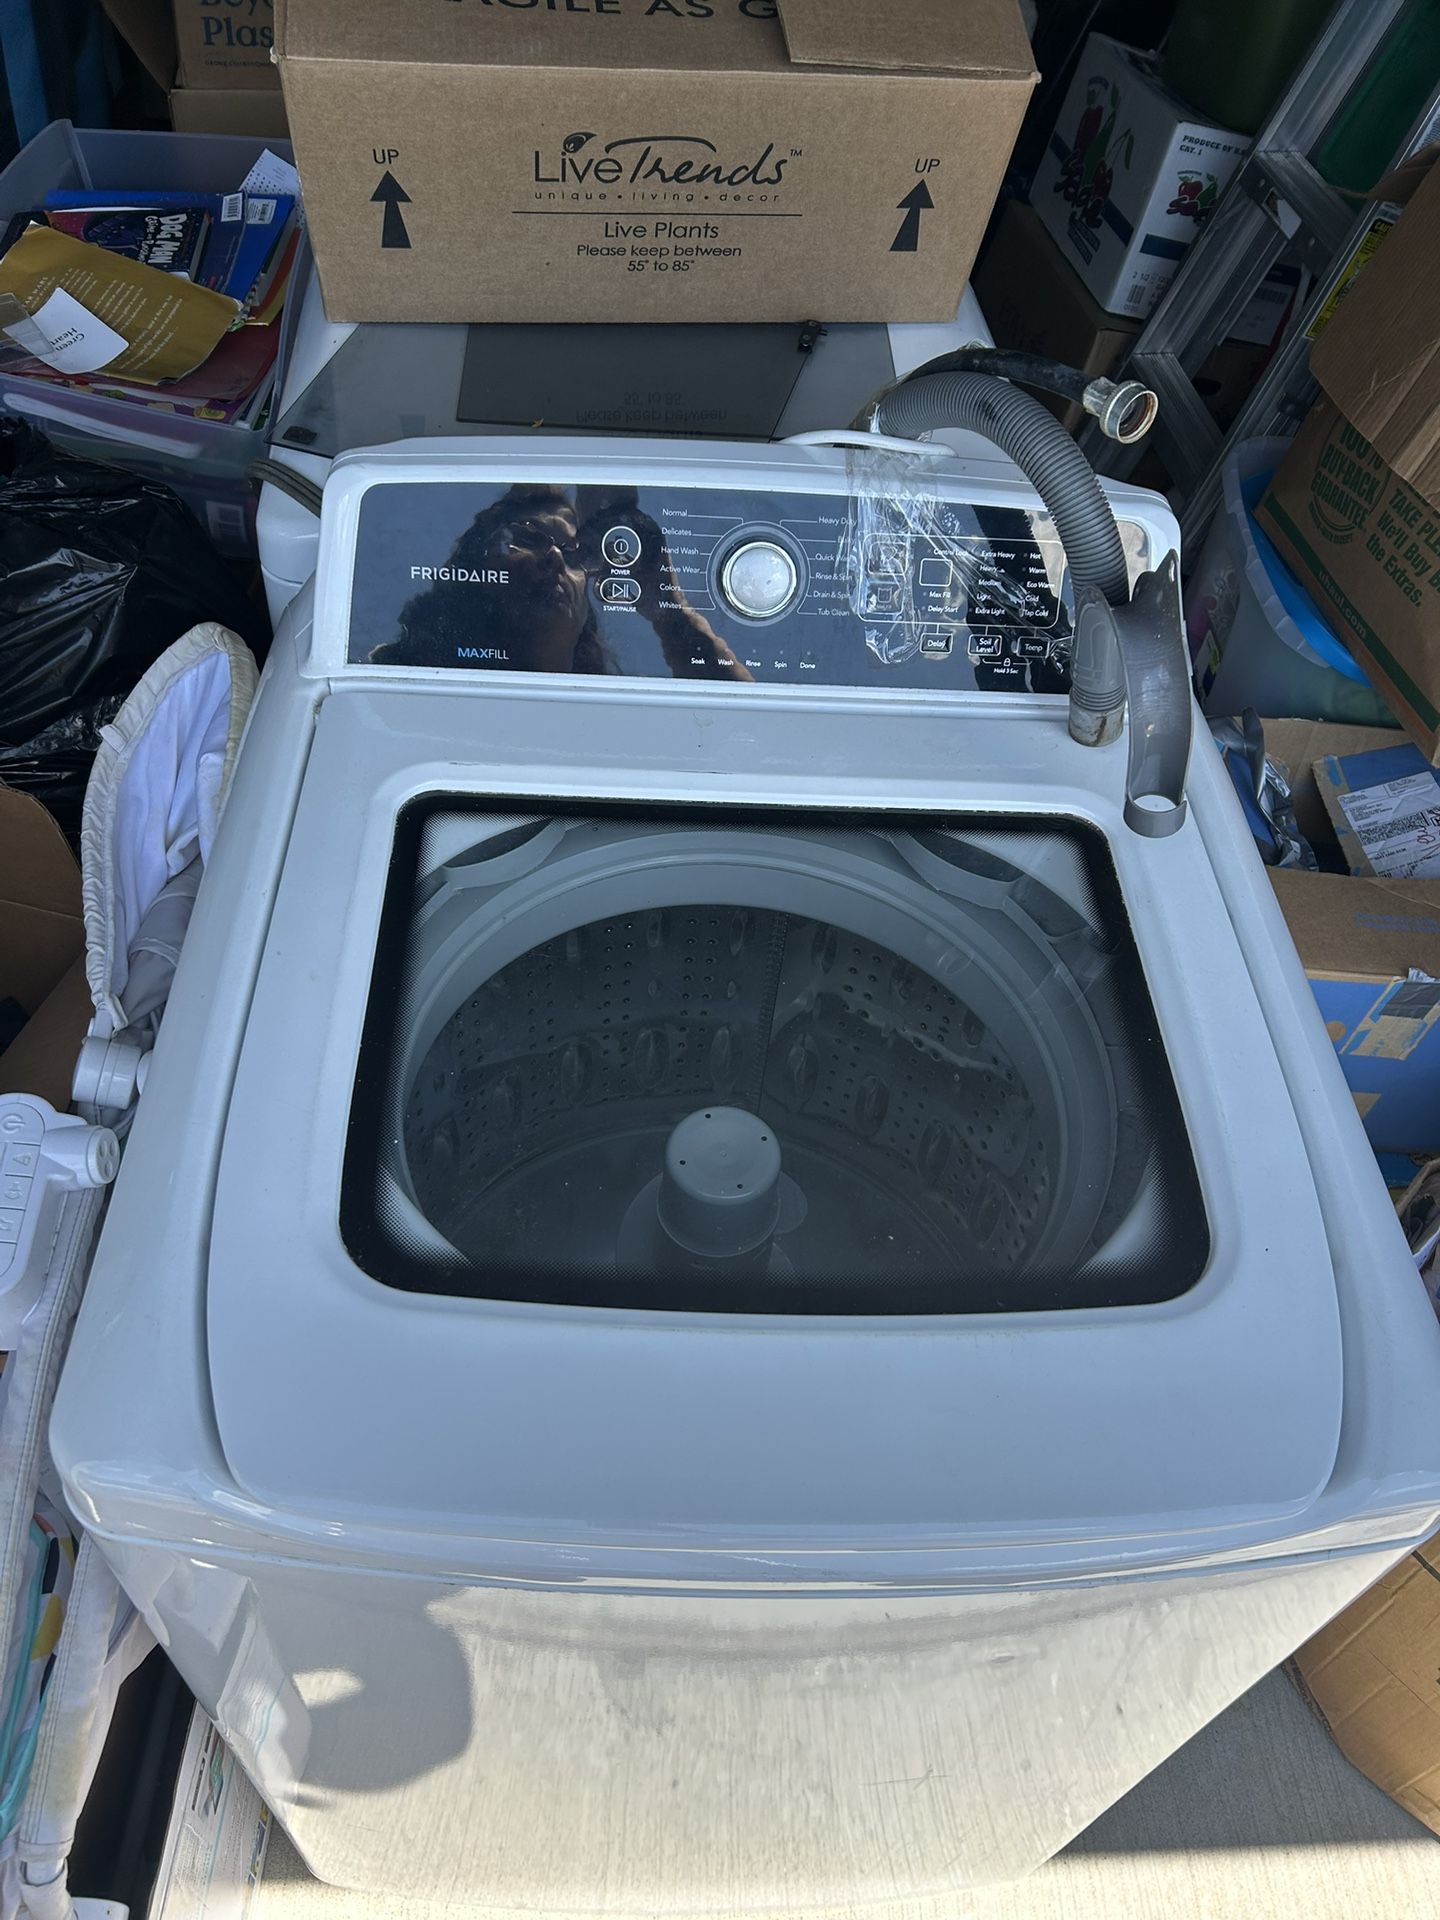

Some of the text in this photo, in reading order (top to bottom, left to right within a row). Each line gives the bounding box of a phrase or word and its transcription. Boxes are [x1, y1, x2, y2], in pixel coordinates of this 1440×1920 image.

[372, 148, 400, 165] UP
[534, 136, 788, 187] LiveTrends
[914, 158, 941, 174] UP
[534, 191, 780, 203] unique living decor
[155, 213, 188, 240] DOG
[604, 221, 720, 239] Live Plants
[147, 239, 181, 264] MAN
[576, 244, 742, 258] Please keep between
[653, 260, 669, 272] to
[50, 327, 78, 346] Heart
[55, 333, 86, 351] Green
[662, 508, 688, 517] Normal
[1389, 487, 1423, 529] TAKE
[818, 516, 840, 526] Heavy
[661, 527, 692, 536] Delicates
[1377, 509, 1410, 550] We'll
[1403, 542, 1432, 577] Buy
[660, 546, 699, 555] Hand Wash
[997, 551, 1016, 560] Heavy
[815, 553, 835, 562] Quick
[410, 564, 510, 584] FRIGIDAIRE
[659, 564, 700, 574] Active Wear
[1366, 533, 1386, 562] the
[1383, 554, 1423, 608] Extras.
[815, 572, 853, 583] Rinse & Spin
[659, 583, 681, 592] Colors
[813, 590, 831, 598] Drain
[830, 591, 837, 599] &
[603, 605, 637, 613] START/PAUSE
[659, 601, 682, 610] Whites
[1320, 569, 1367, 639] uhaul.com
[817, 608, 850, 617] Tub Clean
[927, 605, 959, 614] Delay Start
[990, 608, 1006, 616] Light
[1034, 609, 1049, 617] Cold
[927, 639, 946, 648] Delay
[979, 638, 992, 646] Soil
[976, 645, 994, 653] Level
[1024, 643, 1043, 652] Temp
[457, 647, 510, 660] MAXFILL
[691, 657, 816, 670] Soak Wash Rinse Spin Done
